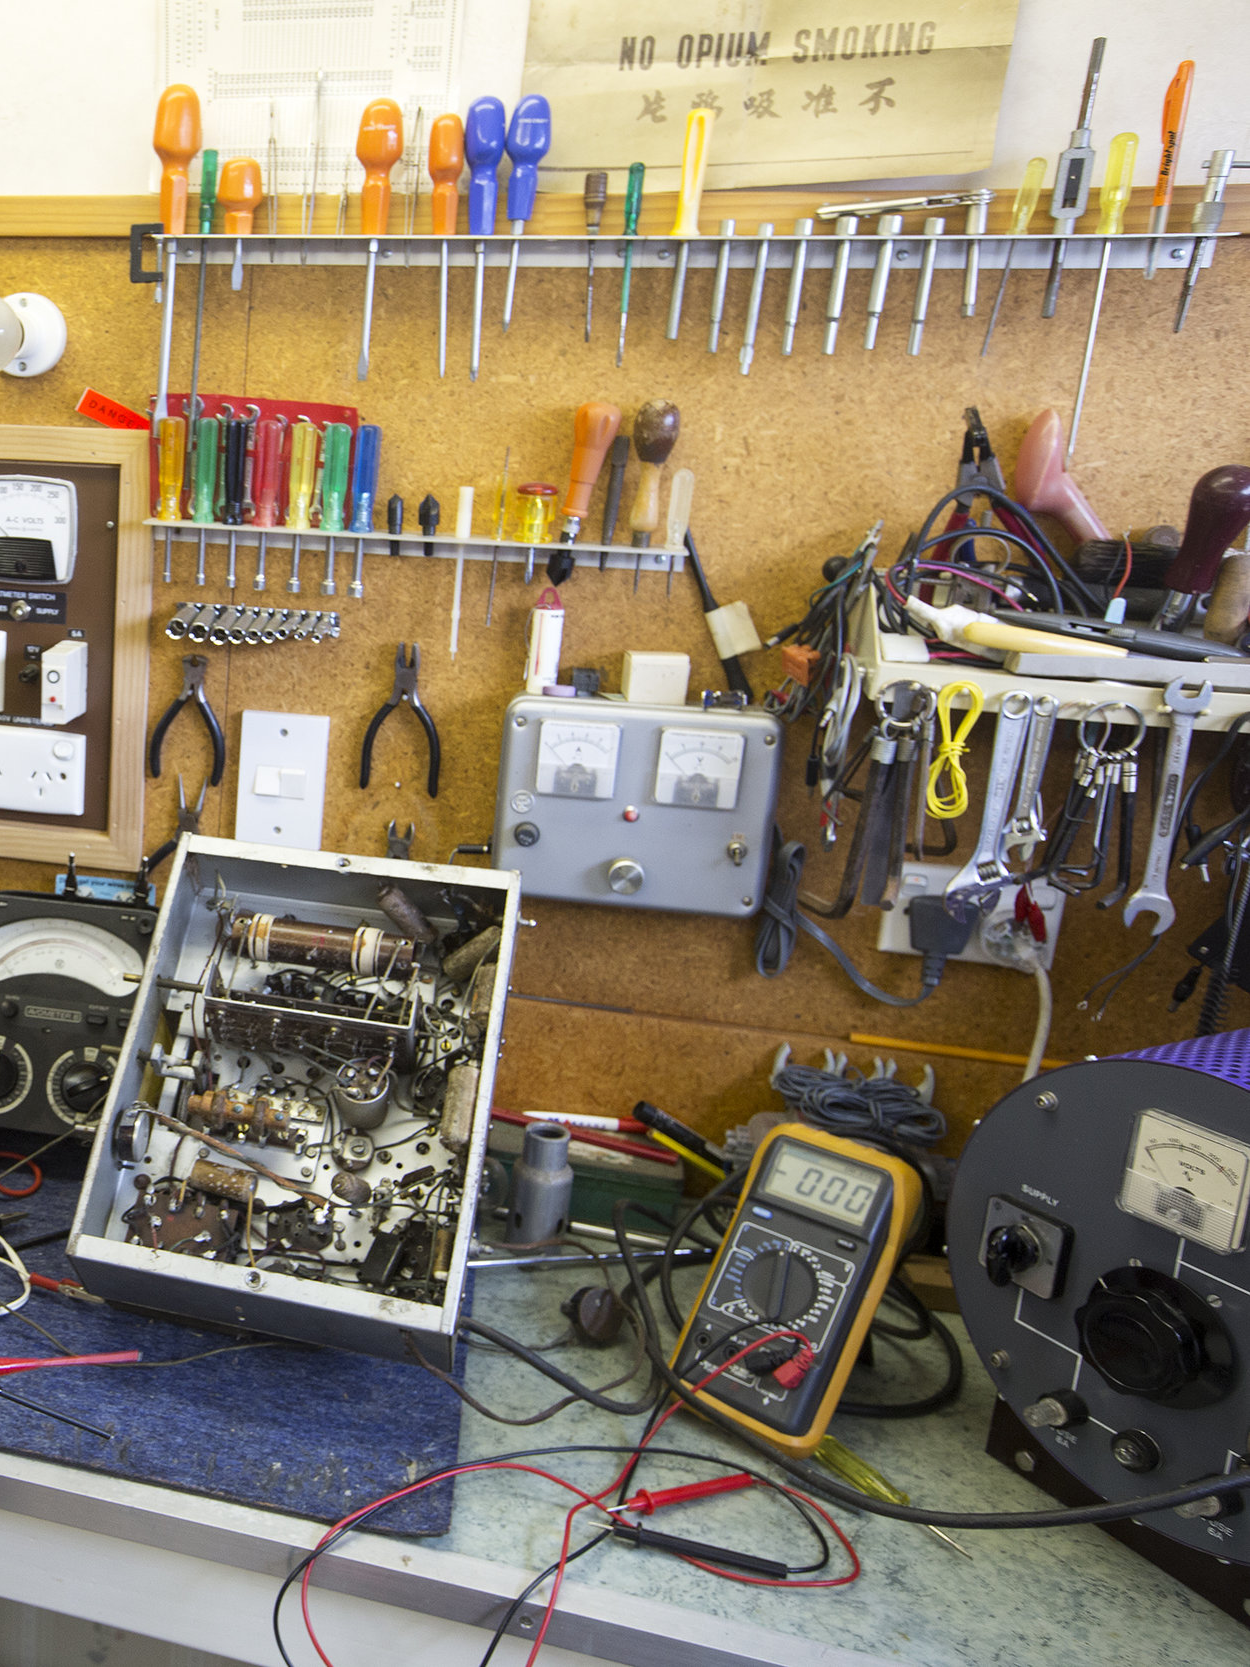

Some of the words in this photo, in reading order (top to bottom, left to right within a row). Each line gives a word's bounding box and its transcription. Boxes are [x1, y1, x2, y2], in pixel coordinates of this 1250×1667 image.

[618, 35, 656, 71] NO
[676, 31, 771, 69] OPIUM
[792, 21, 937, 64] SMOKING
[23, 517, 45, 525] VOLTS
[28, 592, 56, 600] SWITCH
[1179, 1161, 1206, 1176] VOLTS
[1021, 1183, 1059, 1207] SUPPLY
